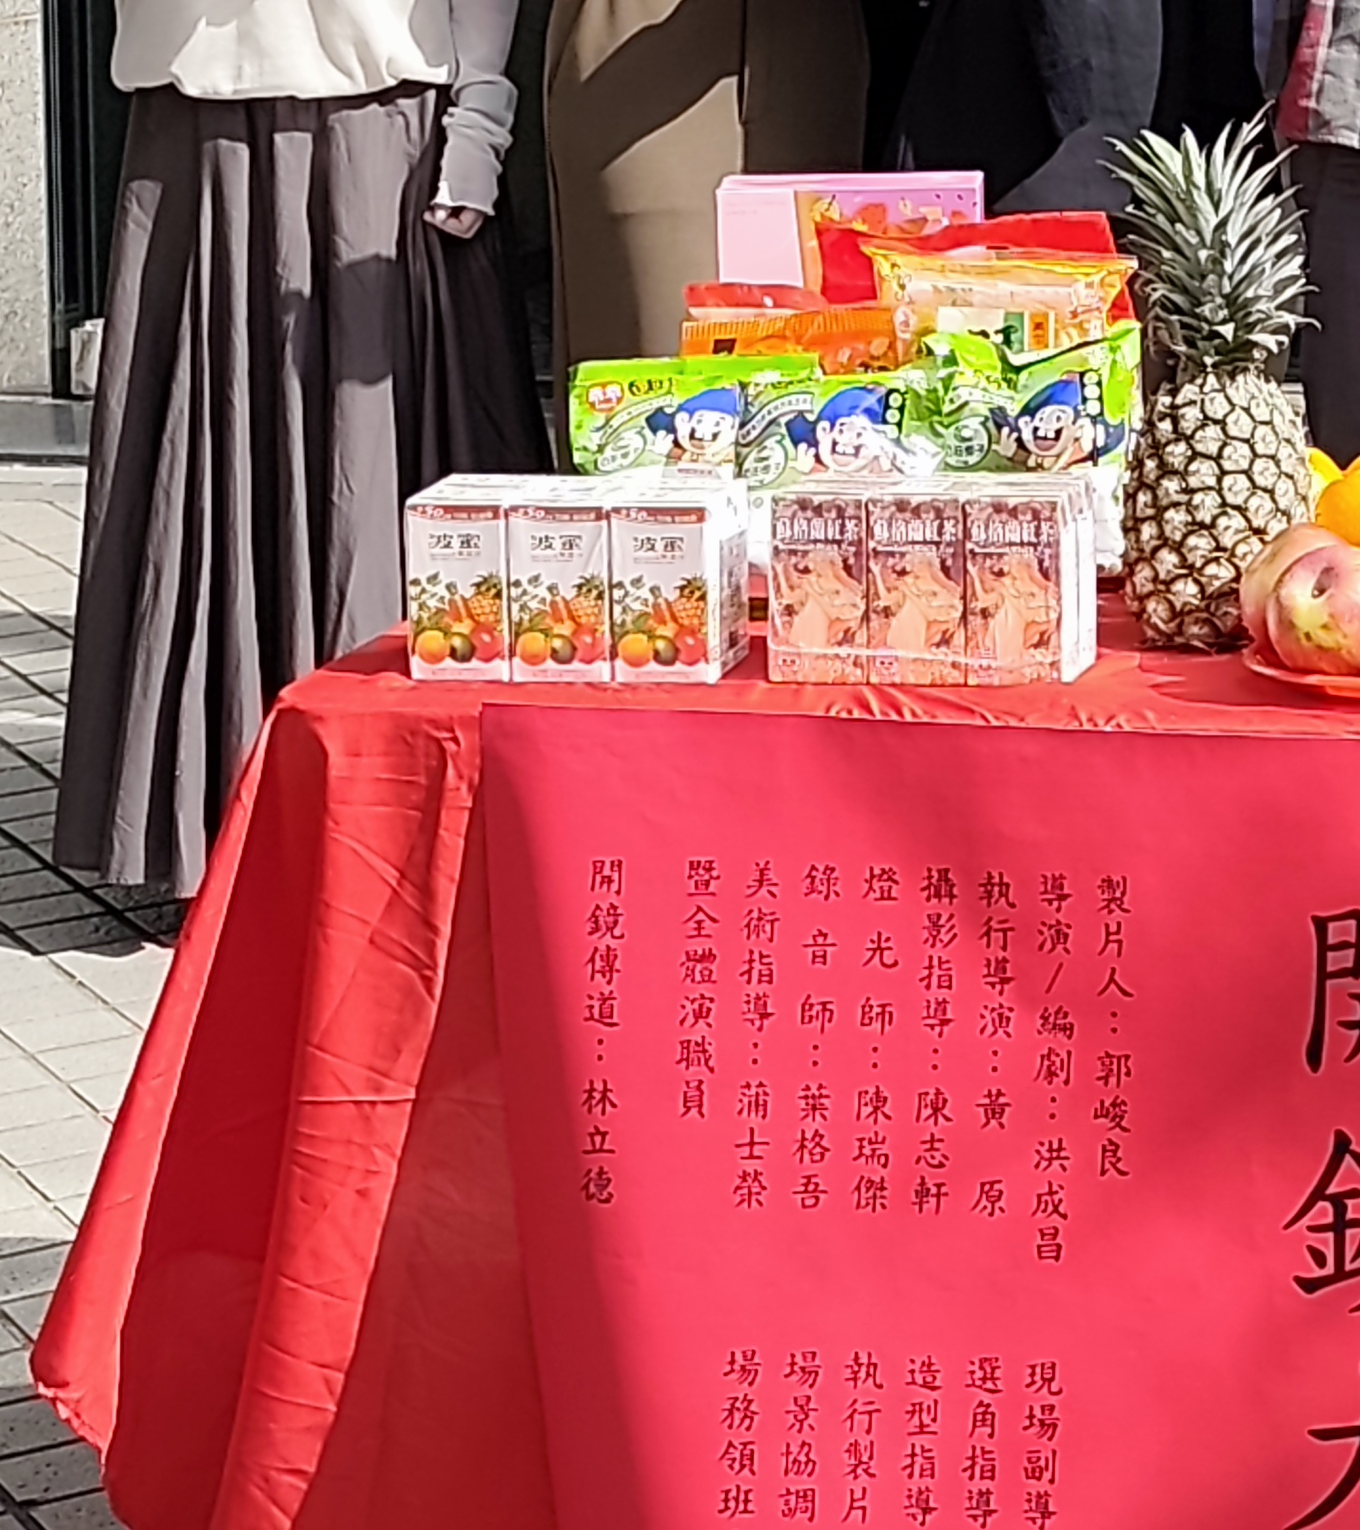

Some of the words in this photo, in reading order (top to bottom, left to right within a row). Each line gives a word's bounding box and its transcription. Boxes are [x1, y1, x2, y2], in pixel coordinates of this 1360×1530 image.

[581, 858, 625, 1205] 開鏡傳道：林立德
[677, 858, 719, 1119] 暨全體演職員
[911, 867, 959, 1216] 攝影指導：陳志軒
[1092, 875, 1135, 1180] 製片人：郭峻良
[717, 1349, 762, 1520] 場務領班
[778, 1350, 822, 1524] 場景協調
[841, 1351, 884, 1524] 執行製片
[901, 1354, 943, 1527] 造型指導
[961, 1356, 1004, 1529] 選角指導
[1021, 1360, 1064, 1530] 現場副導
